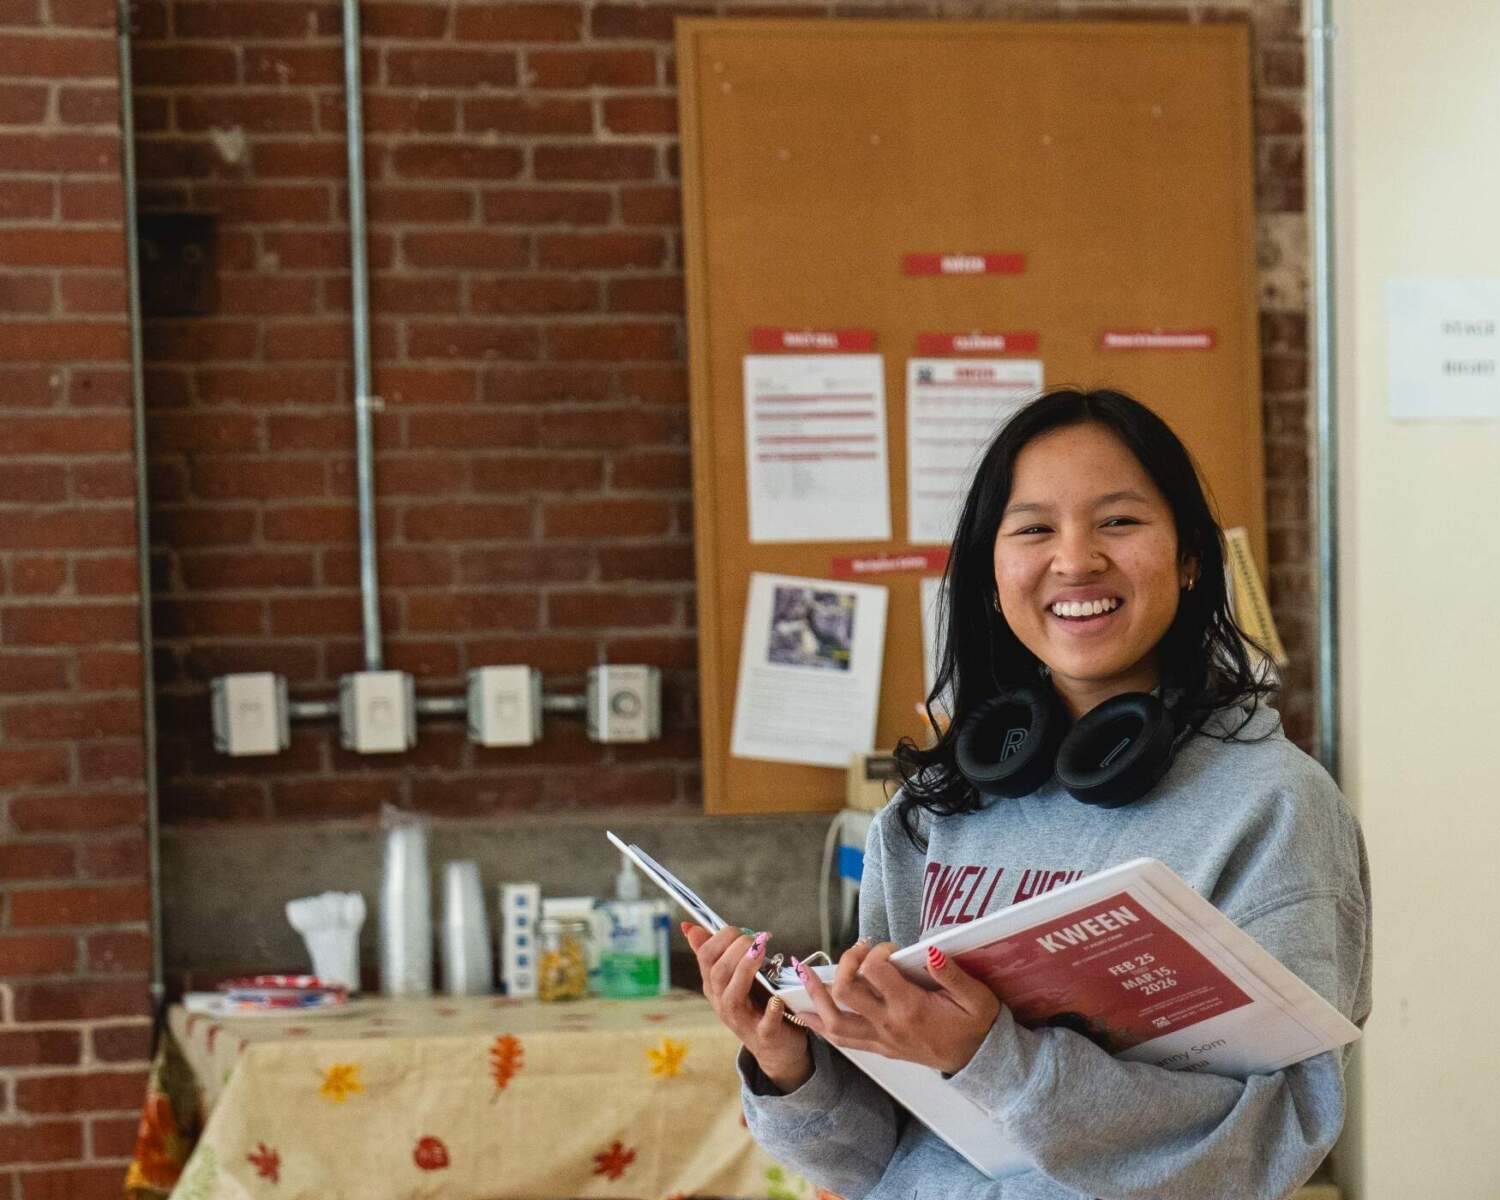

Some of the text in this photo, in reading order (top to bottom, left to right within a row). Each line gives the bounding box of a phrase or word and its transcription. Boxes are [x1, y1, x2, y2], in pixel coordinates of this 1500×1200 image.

[918, 862, 1005, 937] OWELL
[1036, 905, 1140, 953] KWEEN
[1108, 961, 1136, 976] FEB
[1134, 952, 1155, 966] 25
[1121, 972, 1155, 990] MAR
[1140, 977, 1177, 996] 2026
